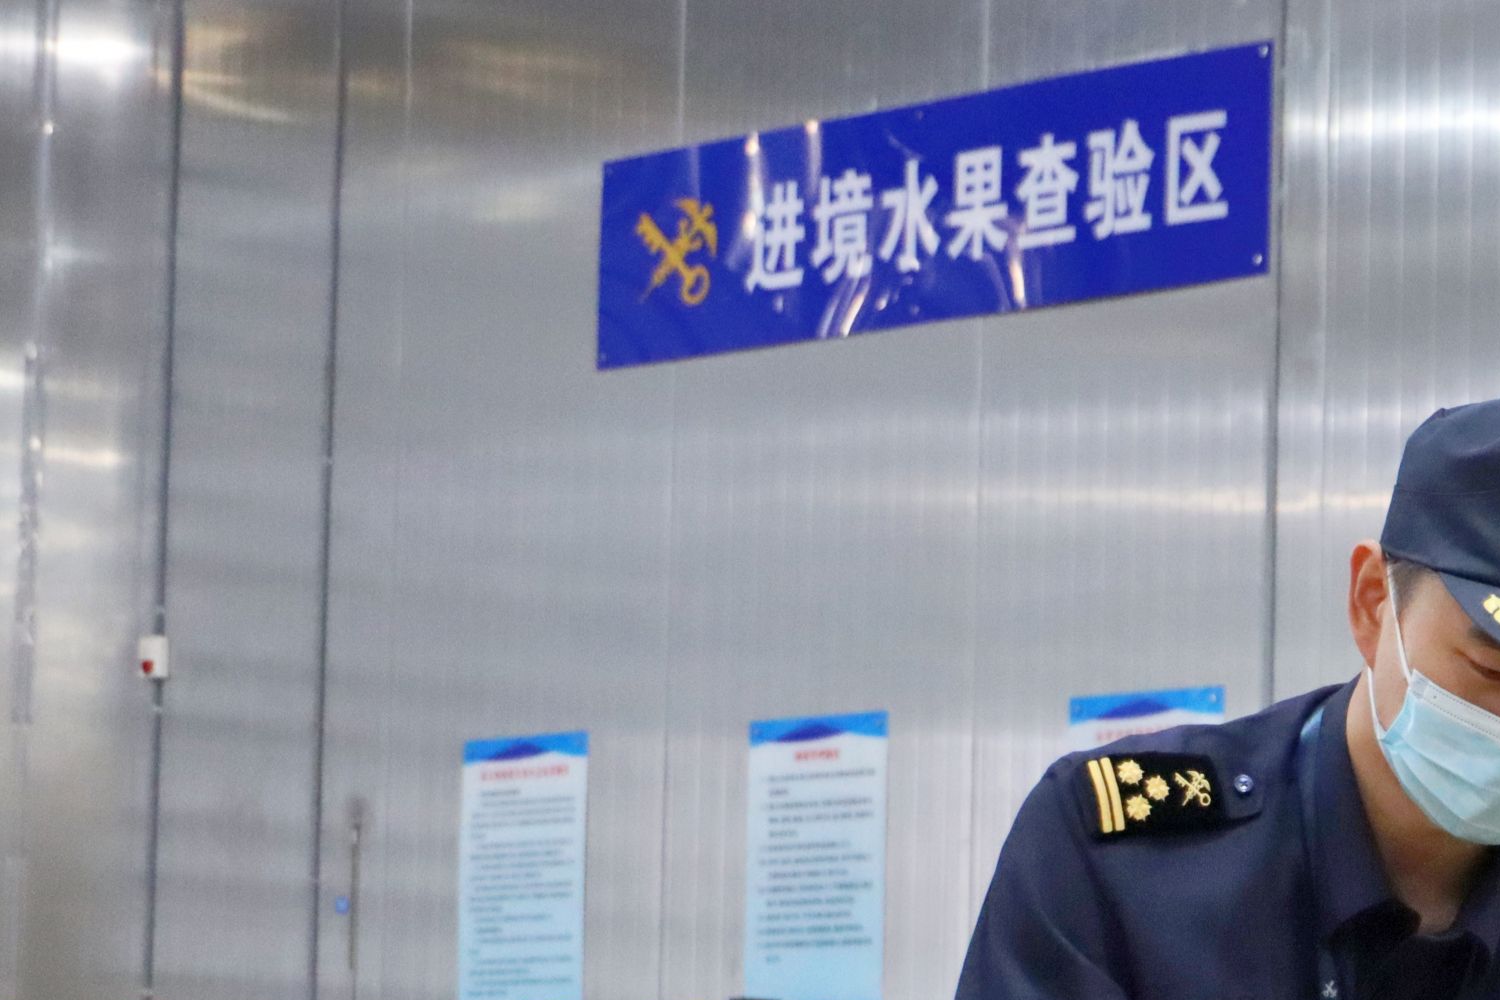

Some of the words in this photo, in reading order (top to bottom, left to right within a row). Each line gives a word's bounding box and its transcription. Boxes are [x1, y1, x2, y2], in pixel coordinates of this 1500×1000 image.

[745, 110, 1229, 293] 进境水果查验区
